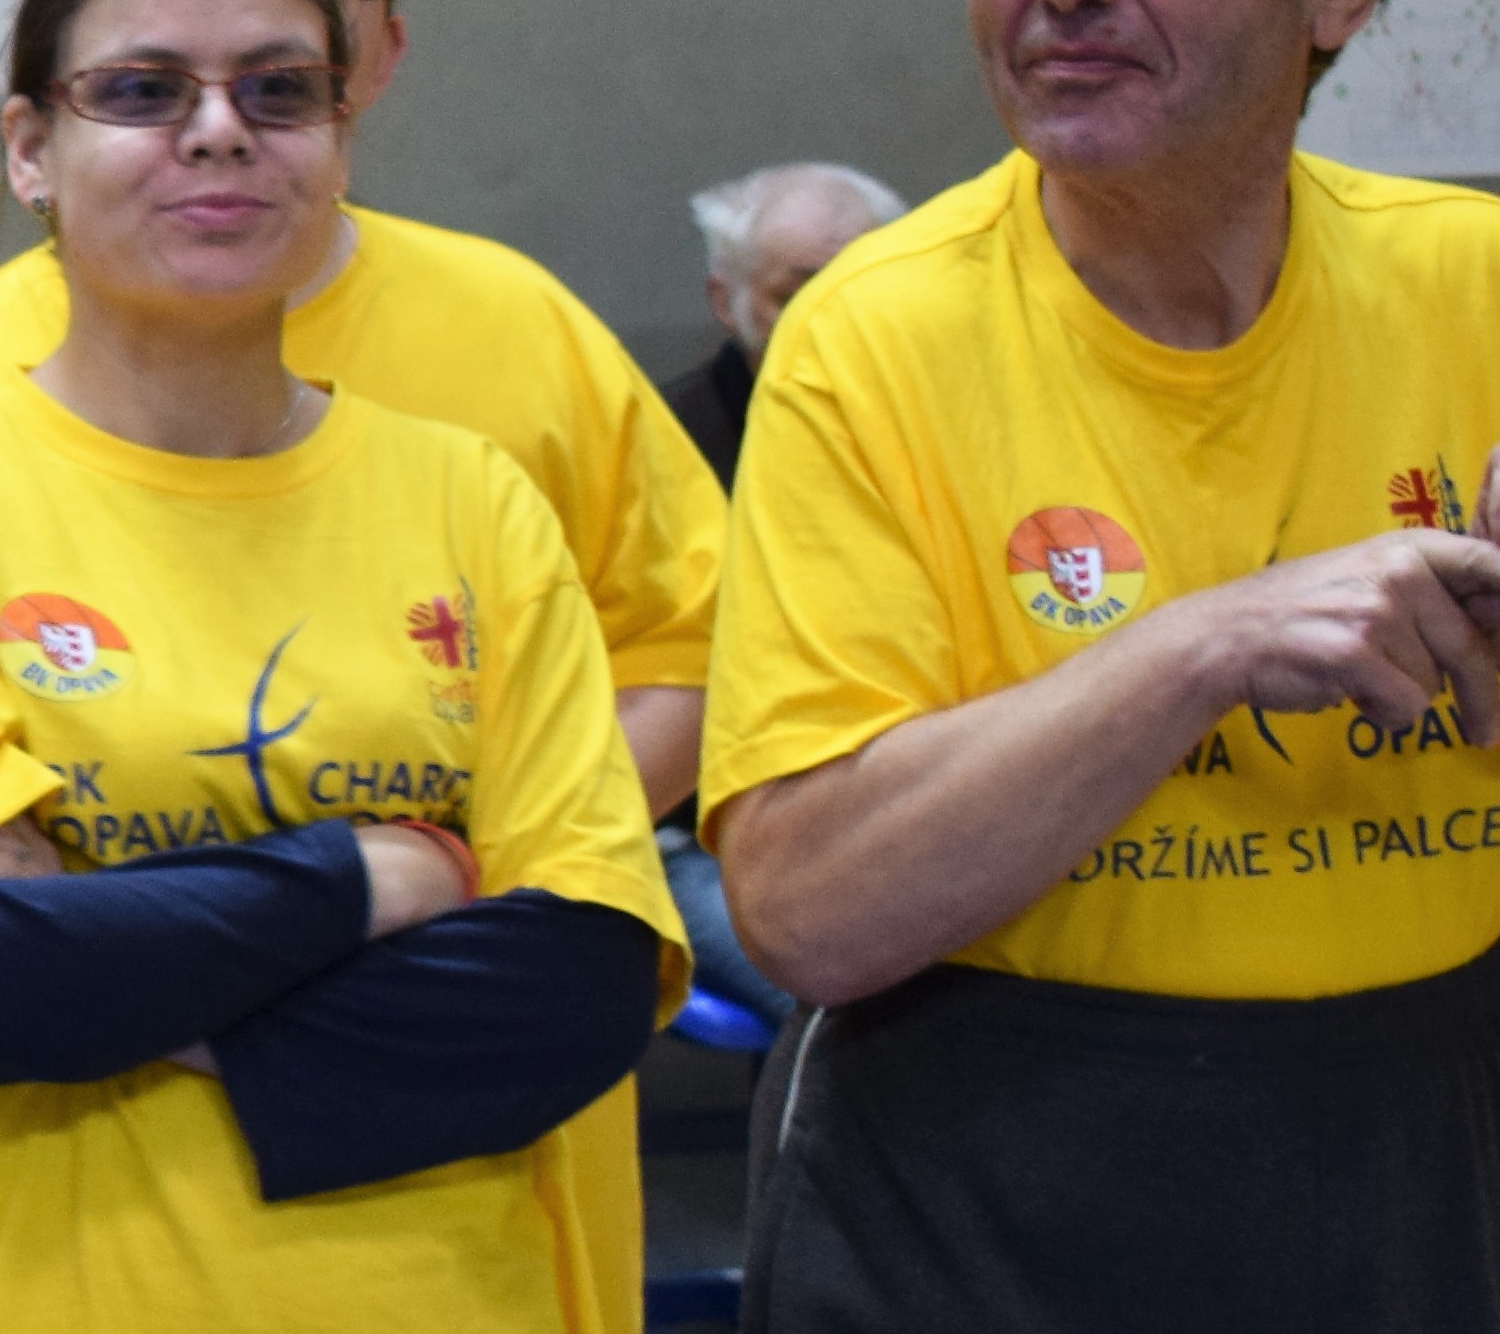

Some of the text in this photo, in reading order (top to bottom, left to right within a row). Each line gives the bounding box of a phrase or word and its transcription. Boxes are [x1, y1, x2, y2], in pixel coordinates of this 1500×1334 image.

[1031, 592, 1126, 627] BK OPAVA
[56, 668, 117, 693] OPAVA
[1287, 826, 1332, 874] SI
